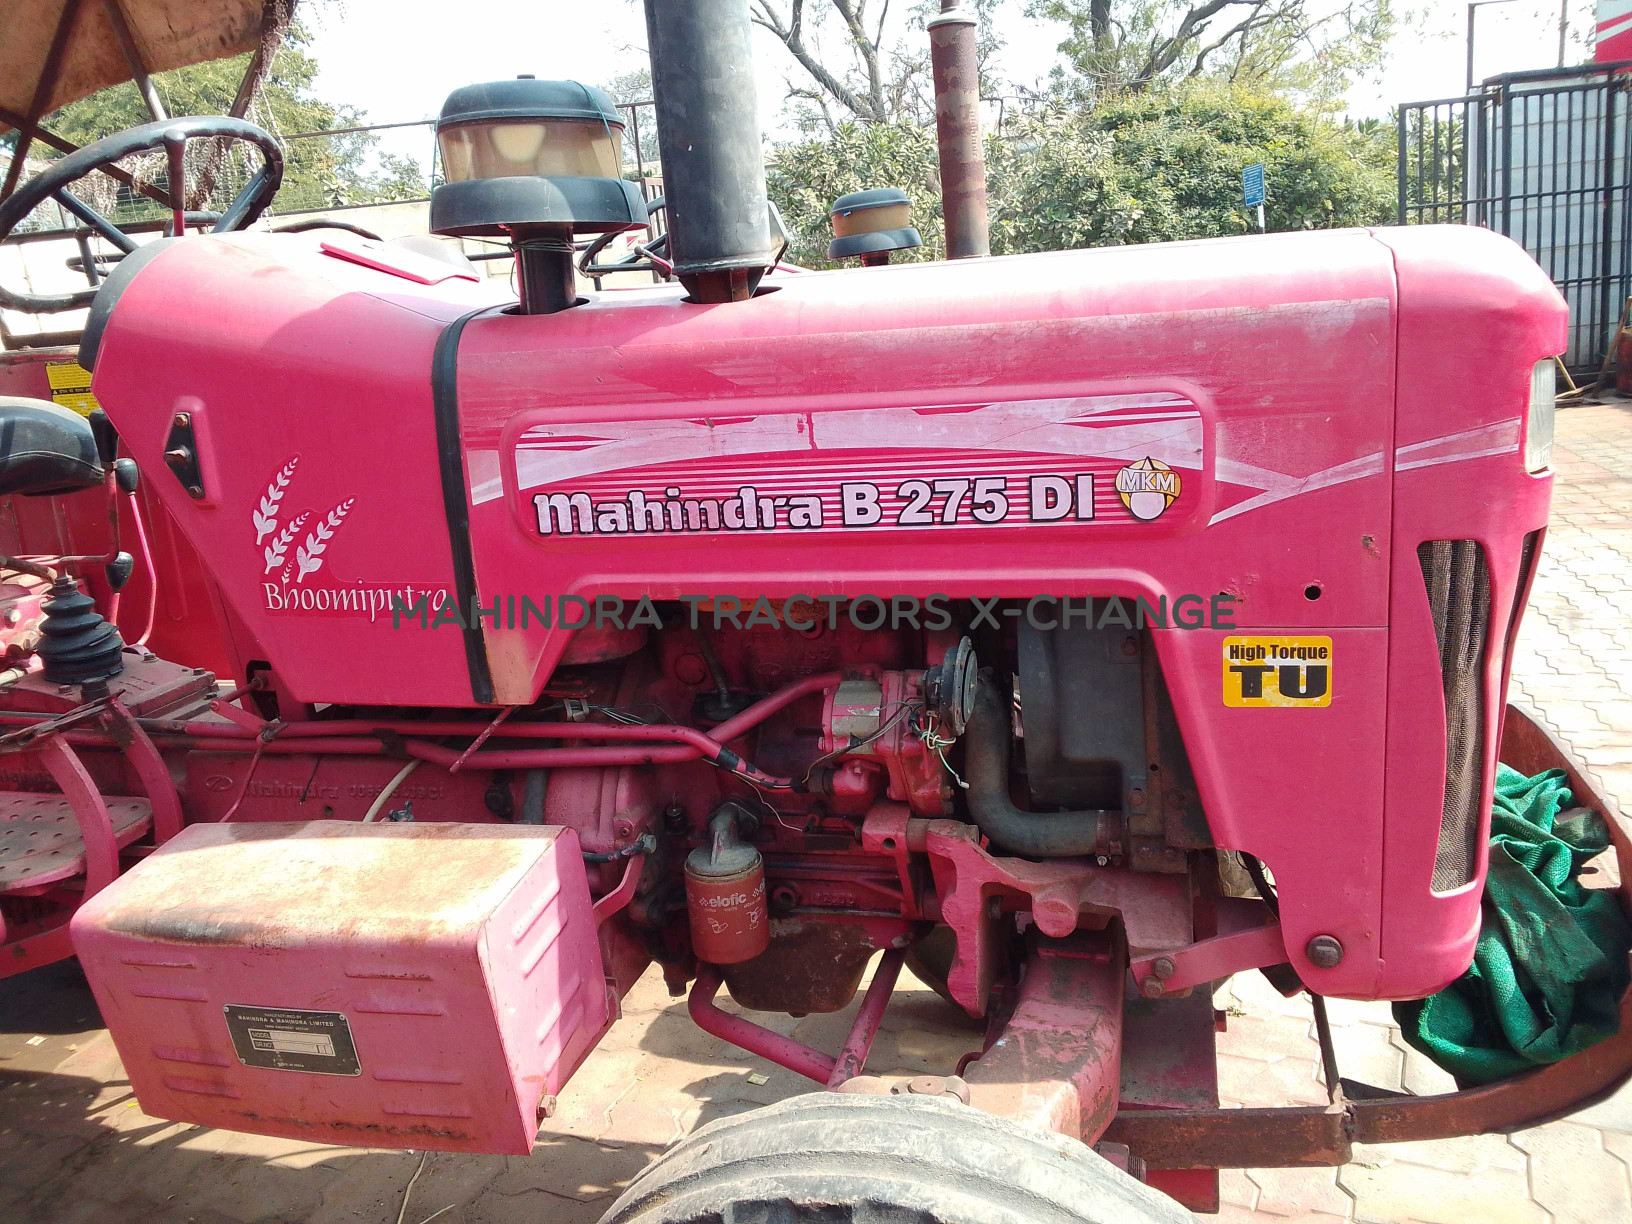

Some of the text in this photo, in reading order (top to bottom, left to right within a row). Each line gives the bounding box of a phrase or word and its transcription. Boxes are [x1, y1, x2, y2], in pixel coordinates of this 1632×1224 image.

[1120, 469, 1175, 493] MKM
[841, 482, 883, 527] B
[897, 476, 1009, 527] 275
[1029, 473, 1095, 522] DI
[261, 583, 450, 622] Bhoomiputra
[1229, 645, 1329, 661] High Torque
[1229, 665, 1328, 698] TU
[709, 893, 747, 907] elofic
[251, 1031, 271, 1039] MODEL
